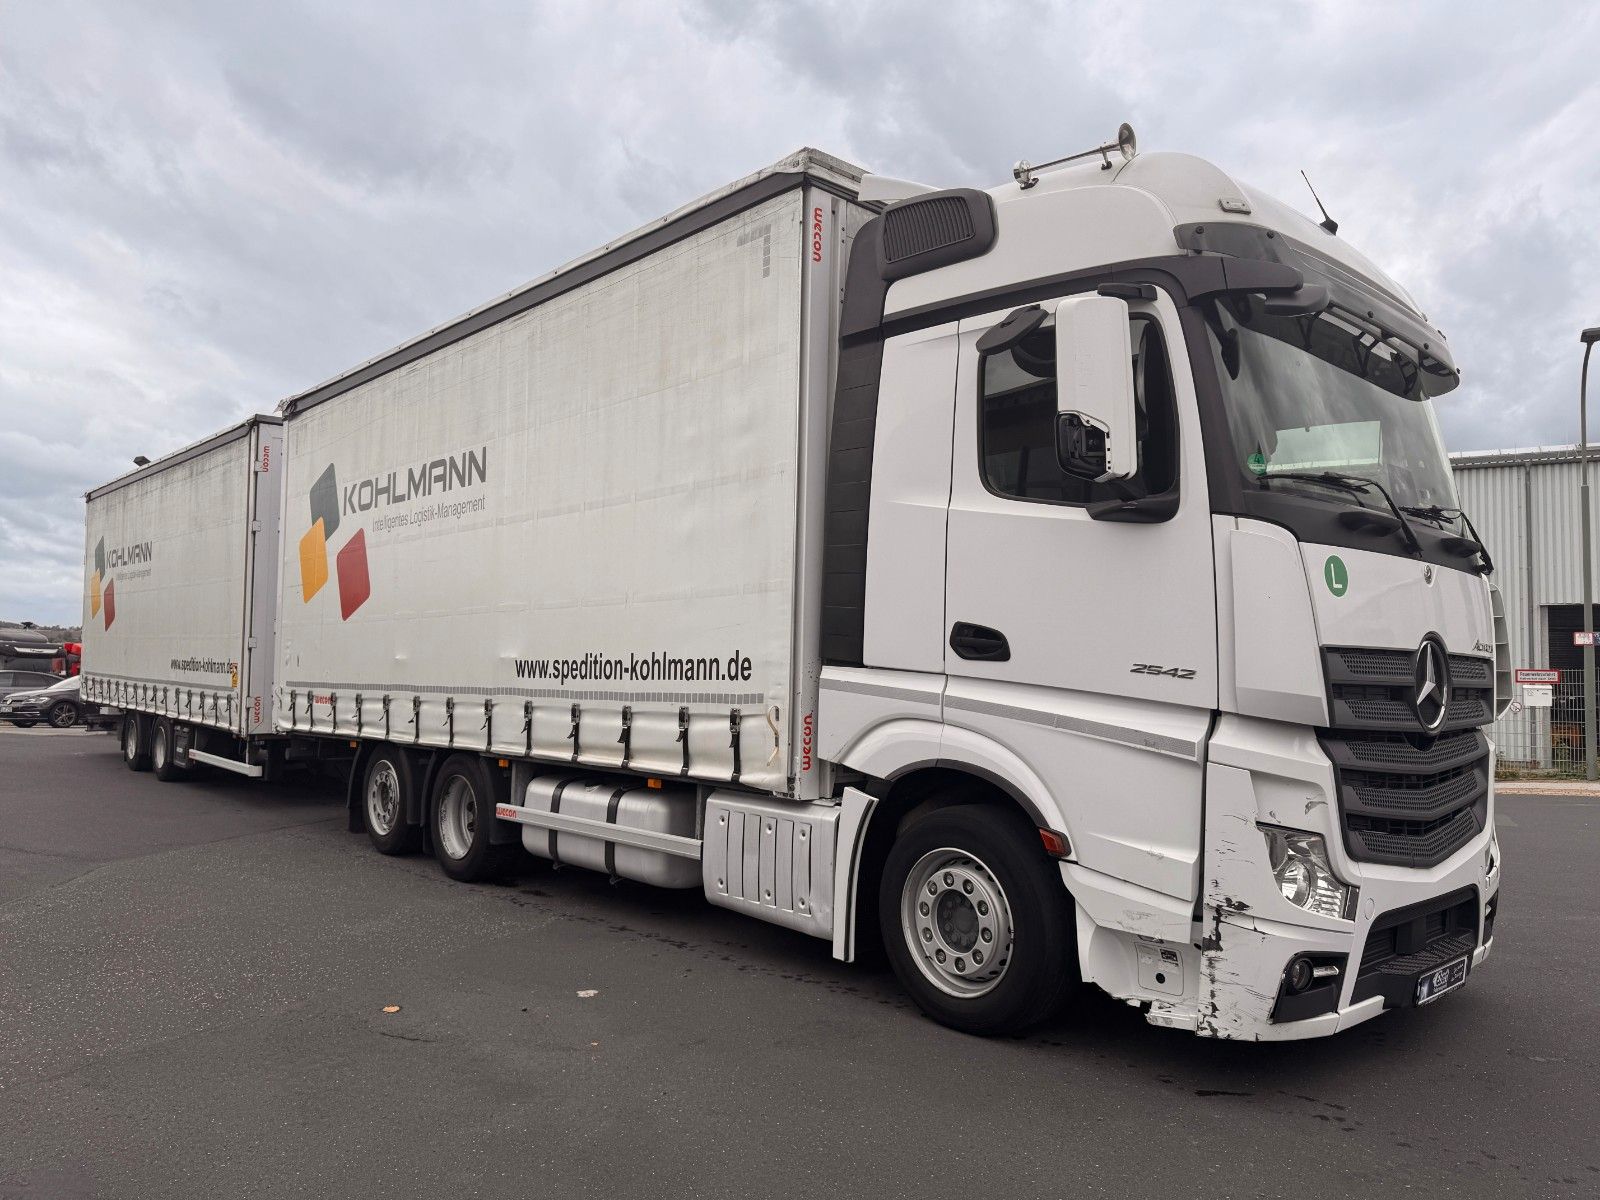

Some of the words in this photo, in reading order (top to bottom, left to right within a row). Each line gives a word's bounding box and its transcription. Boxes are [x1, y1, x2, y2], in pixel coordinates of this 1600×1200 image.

[812, 207, 822, 262] wecon
[262, 445, 270, 472] wecon
[343, 446, 487, 516] KOHLMANN
[372, 513, 409, 533] Intelligentes
[409, 494, 486, 526] Logistik-Management
[1330, 563, 1343, 589] L
[515, 650, 753, 685] www.spedition-kohlmann.de
[1130, 663, 1198, 680] 2542
[253, 696, 262, 723] wecon
[802, 714, 813, 770] wecon
